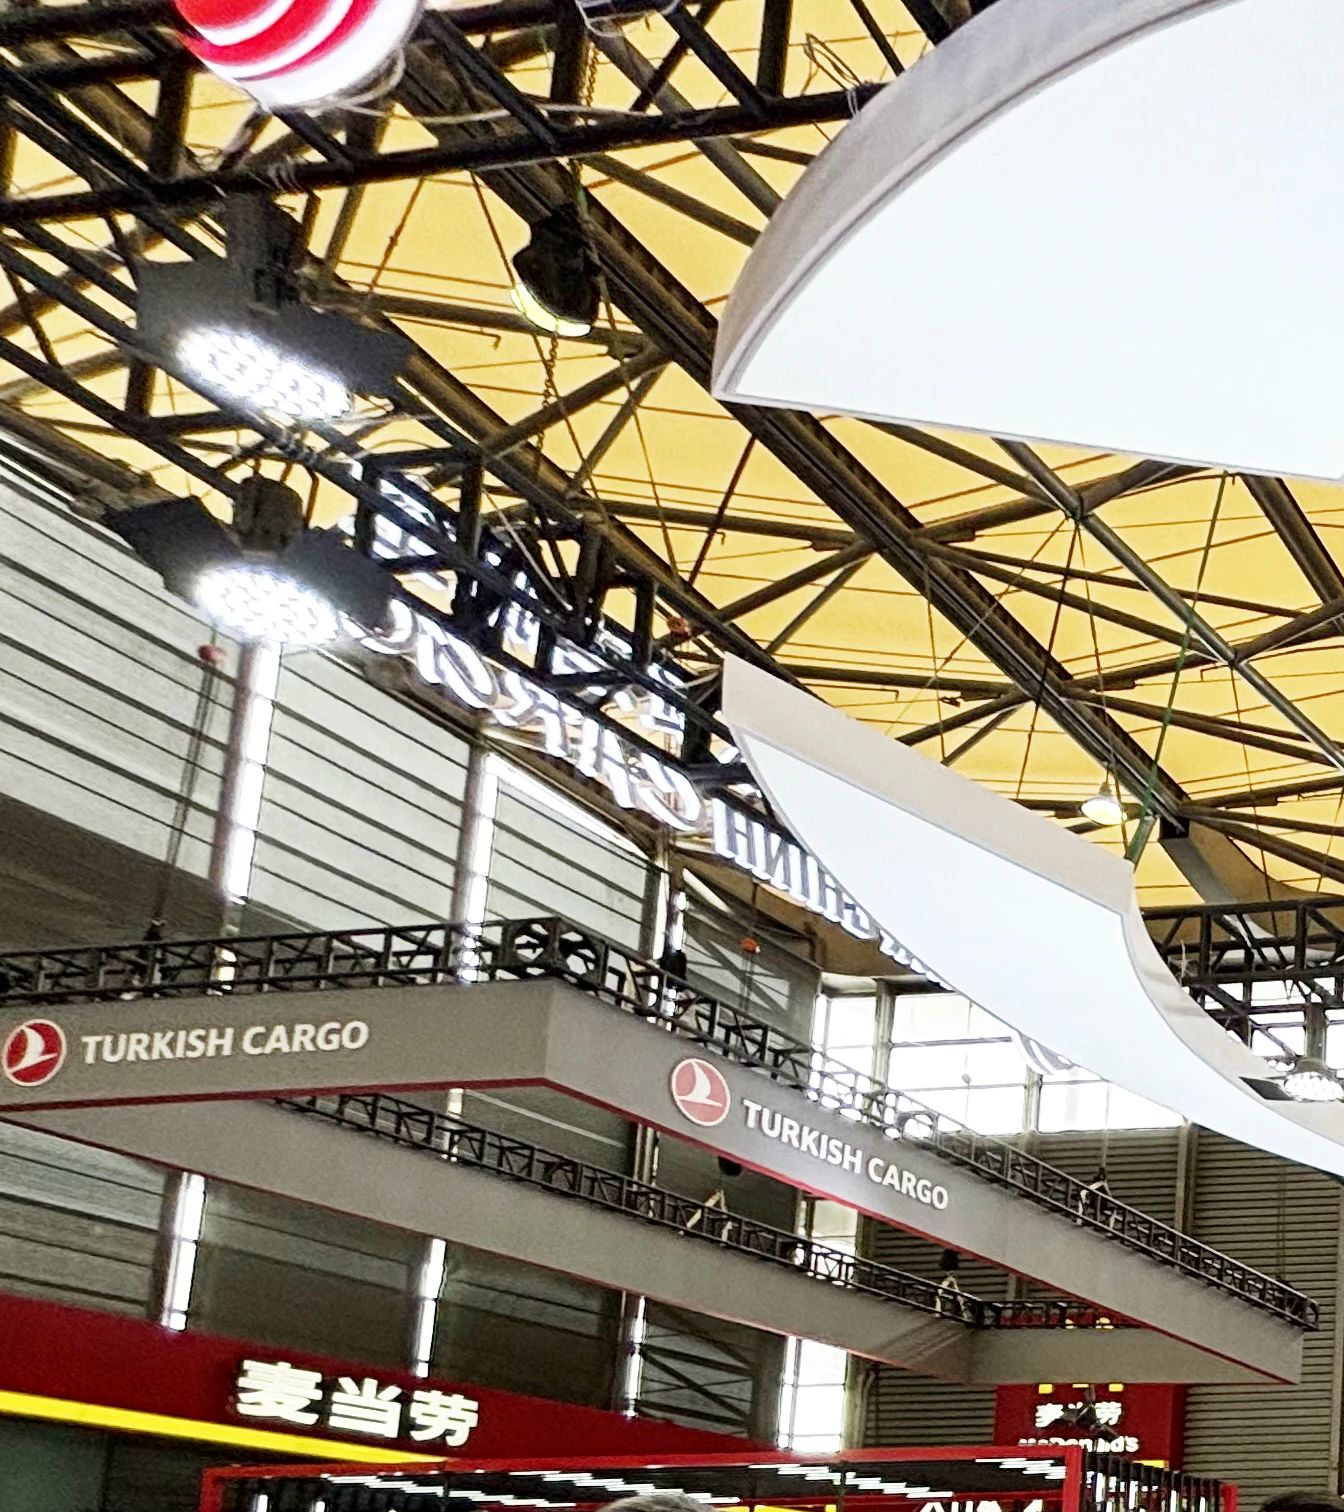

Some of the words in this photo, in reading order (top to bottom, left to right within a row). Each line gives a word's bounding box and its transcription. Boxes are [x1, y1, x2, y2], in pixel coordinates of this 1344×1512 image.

[81, 1026, 236, 1064] TURKISH
[242, 1020, 370, 1056] CARGO
[742, 1099, 864, 1175] TURKISH
[866, 1156, 949, 1211] CARGO
[235, 1359, 480, 1448] 麦当劳
[1034, 1401, 1123, 1429] 麦劳
